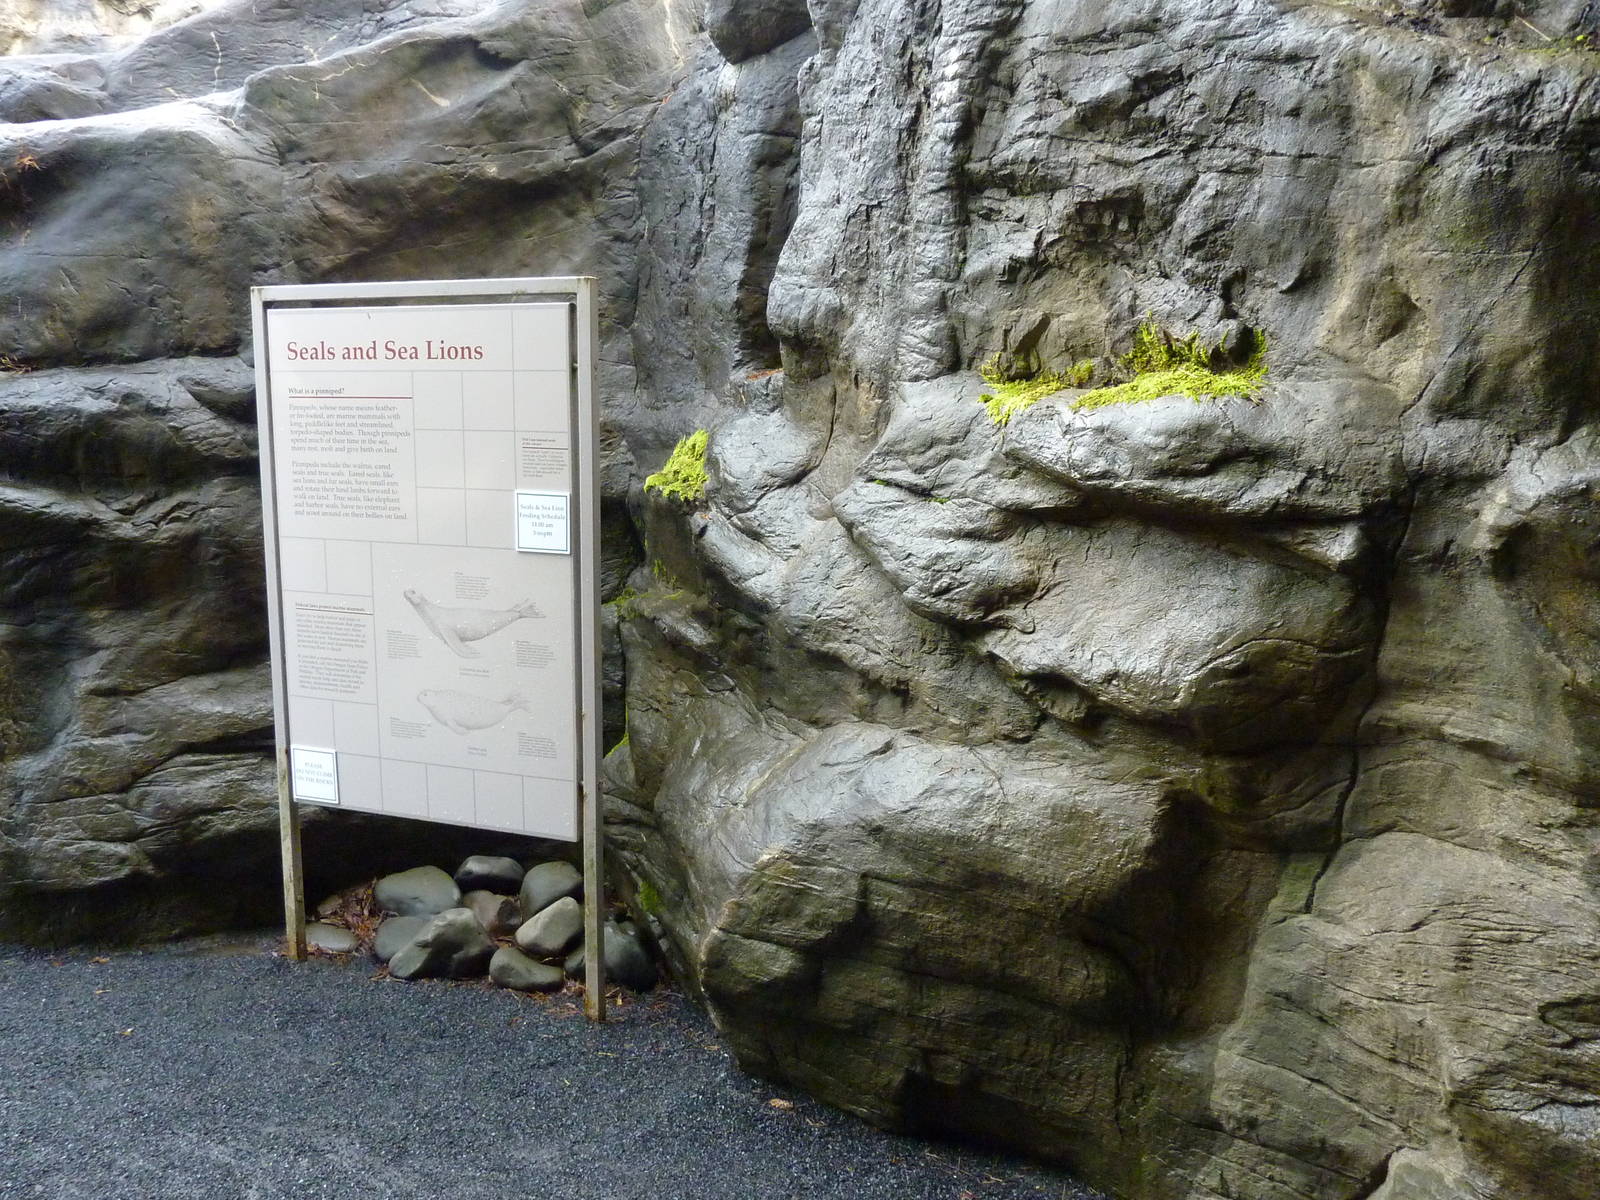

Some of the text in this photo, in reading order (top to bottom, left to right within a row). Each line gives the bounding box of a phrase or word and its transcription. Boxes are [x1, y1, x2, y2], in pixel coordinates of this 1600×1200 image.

[287, 340, 483, 360] Seals and Sea Lions
